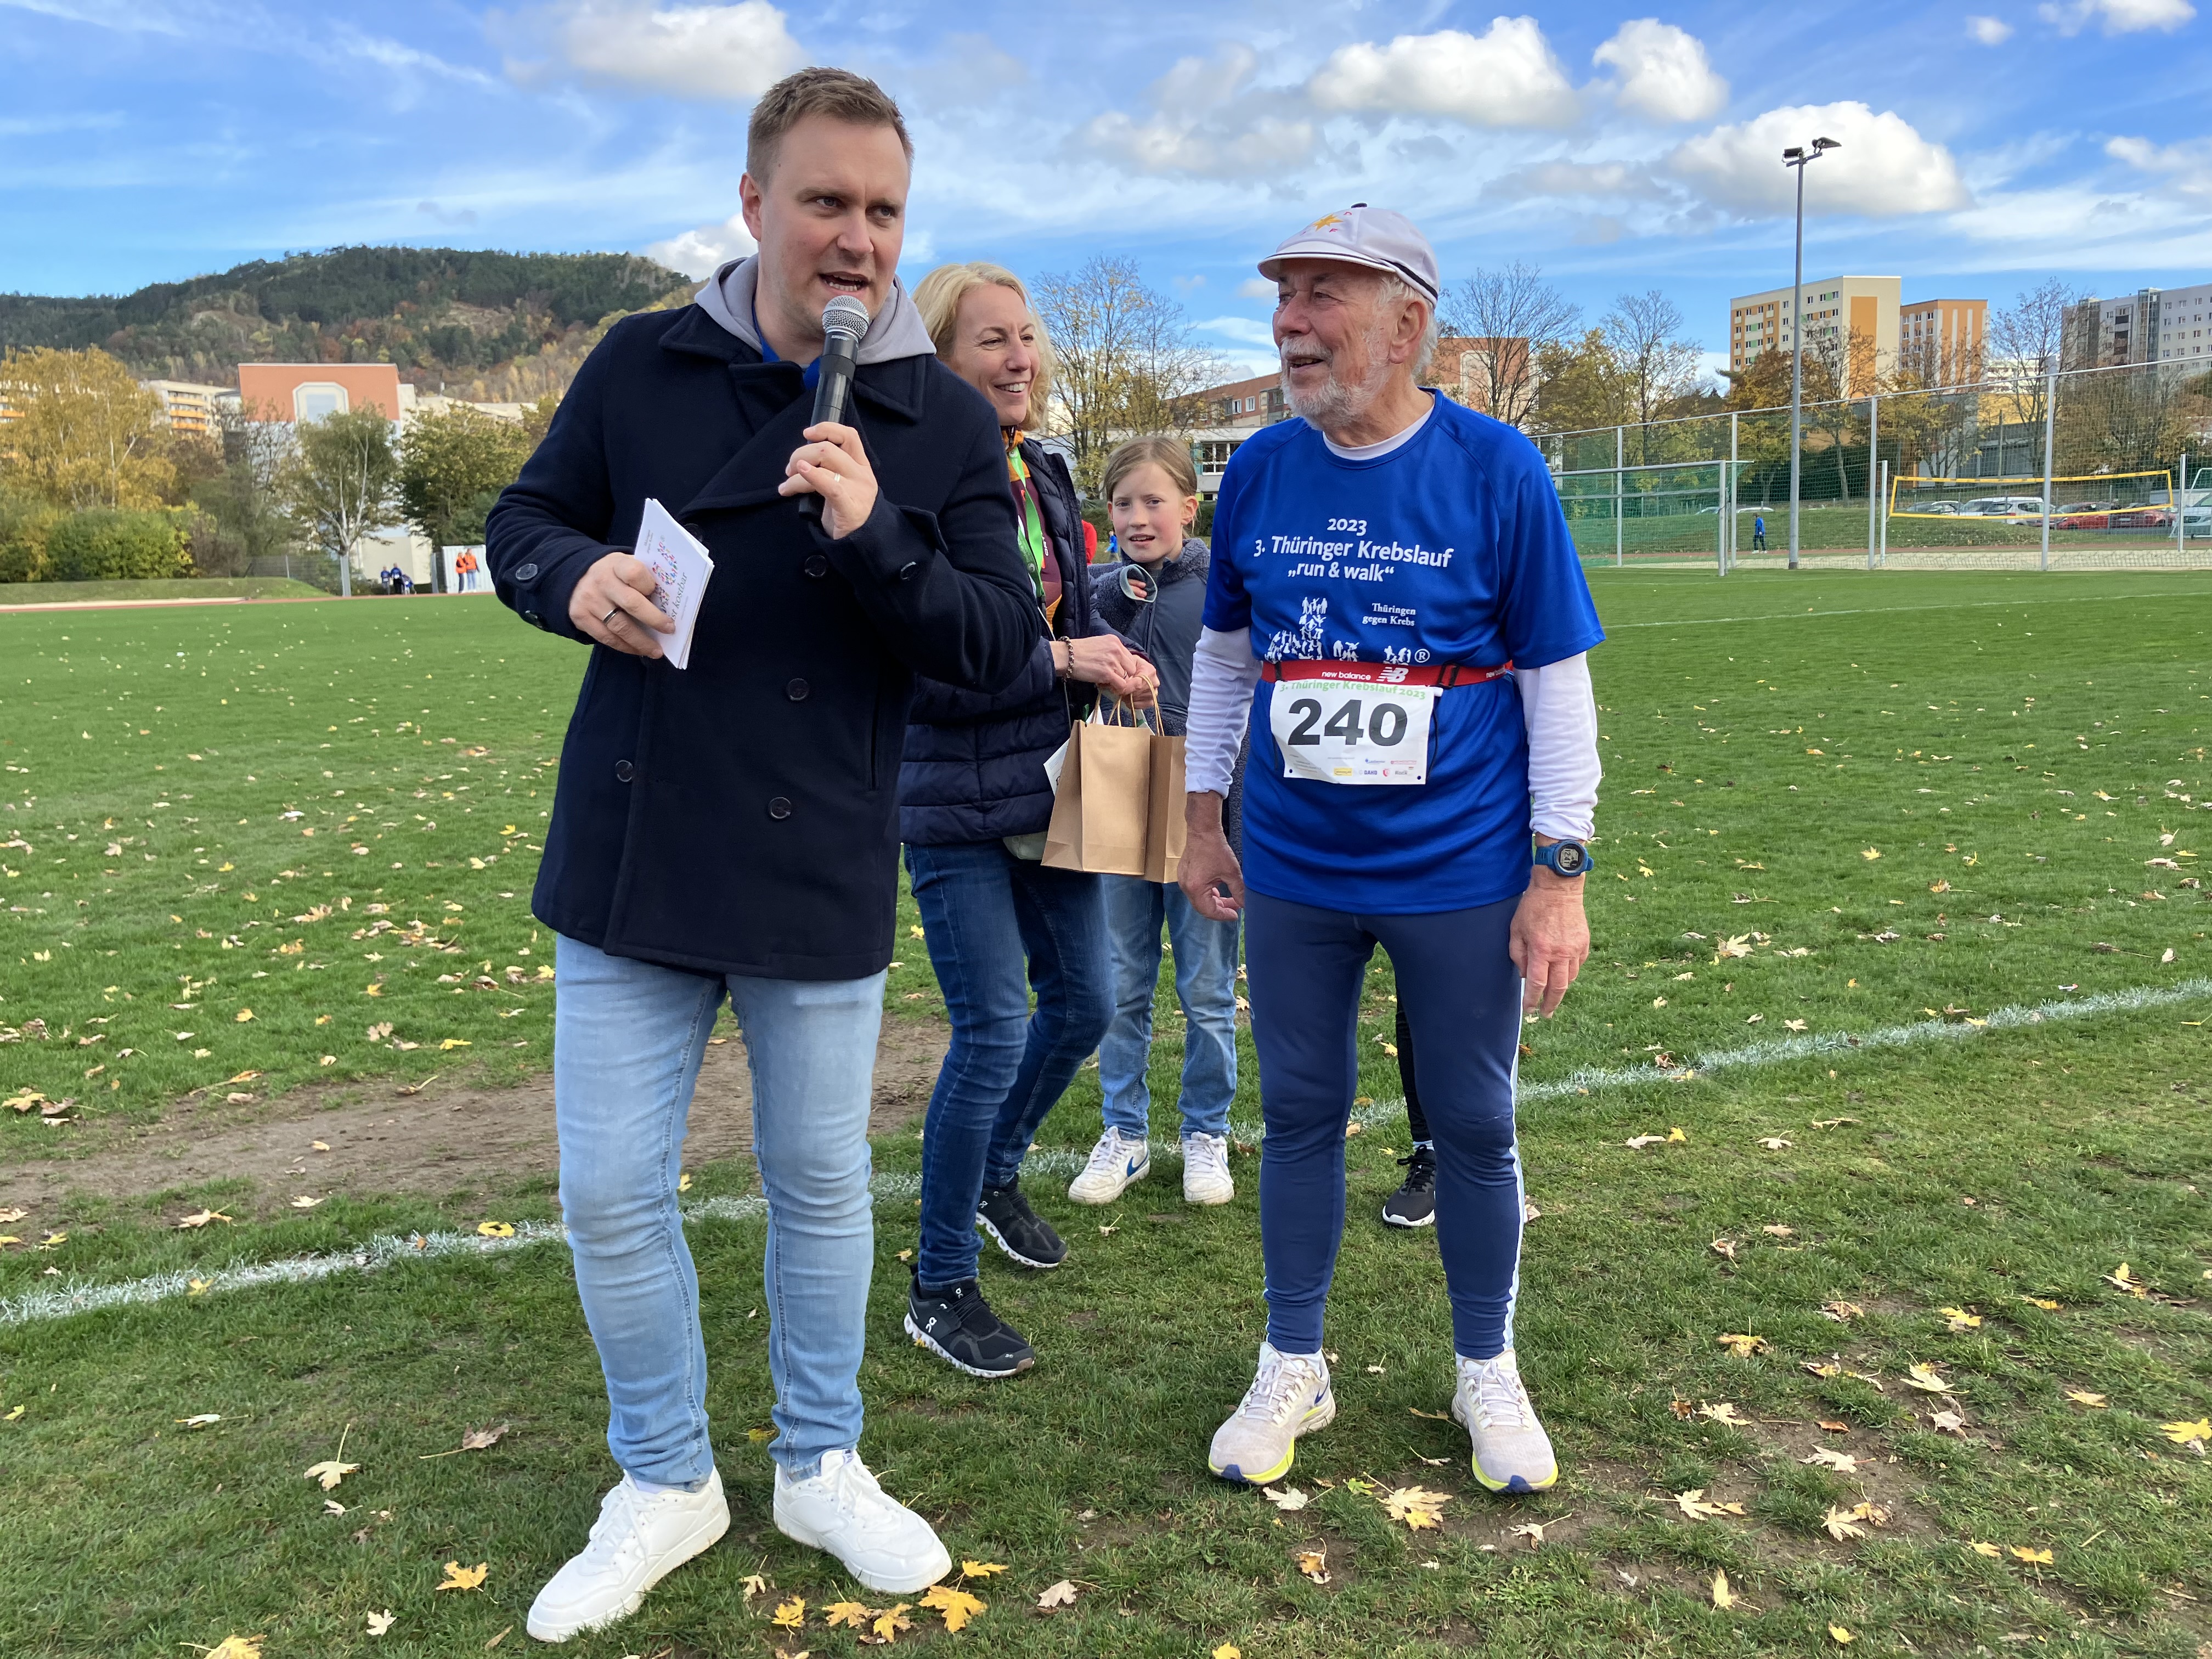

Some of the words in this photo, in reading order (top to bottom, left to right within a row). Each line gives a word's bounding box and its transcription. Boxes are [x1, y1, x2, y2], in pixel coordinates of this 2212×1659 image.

[1327, 518, 1367, 537] 2023
[1253, 539, 1266, 557] 3.
[1271, 535, 1353, 562] Thüringer
[1357, 540, 1454, 568] Krebslauf
[1328, 561, 1340, 578] &
[1372, 602, 1416, 617] Thüringen
[1362, 616, 1387, 625] gegen
[1389, 616, 1415, 627] Krebs
[1339, 671, 1372, 680] balance
[1291, 680, 1341, 692] Thüringer
[1342, 680, 1398, 695] Krebslauf
[1398, 687, 1425, 700] 2023
[1288, 698, 1408, 747] 240
